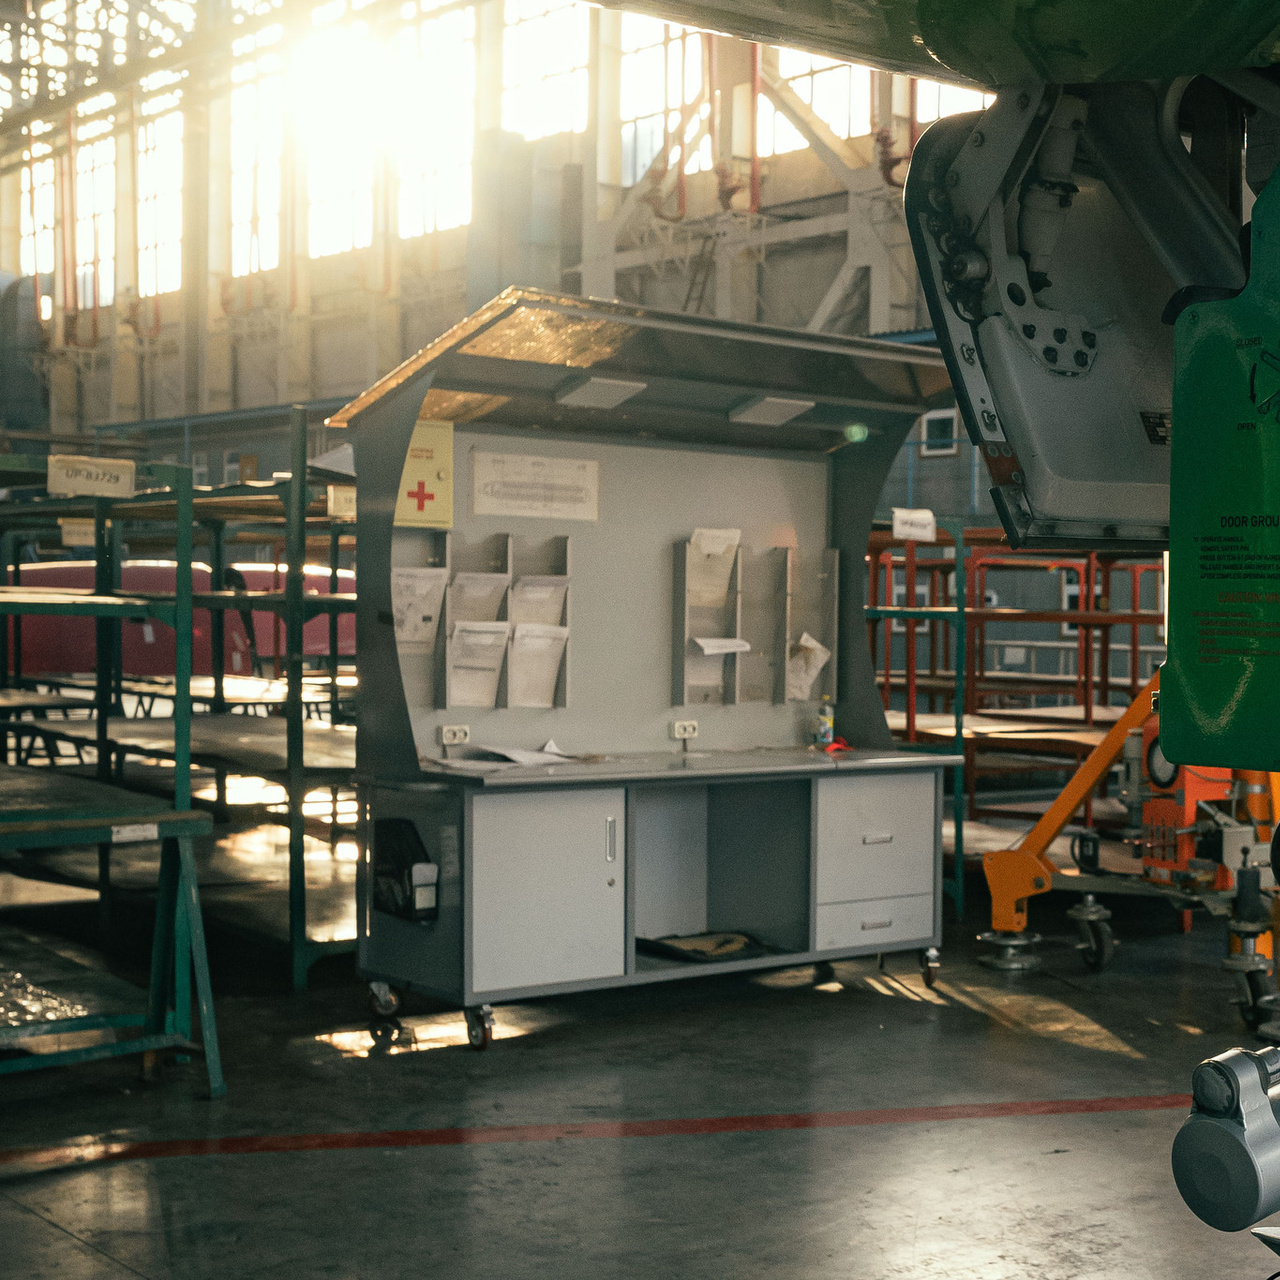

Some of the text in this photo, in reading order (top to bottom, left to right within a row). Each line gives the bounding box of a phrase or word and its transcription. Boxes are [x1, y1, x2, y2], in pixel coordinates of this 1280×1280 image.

[1236, 336, 1263, 347] CLOSED
[1237, 422, 1257, 431] OPEN
[1220, 516, 1248, 528] DOOR
[1218, 592, 1262, 604] CAUTION
